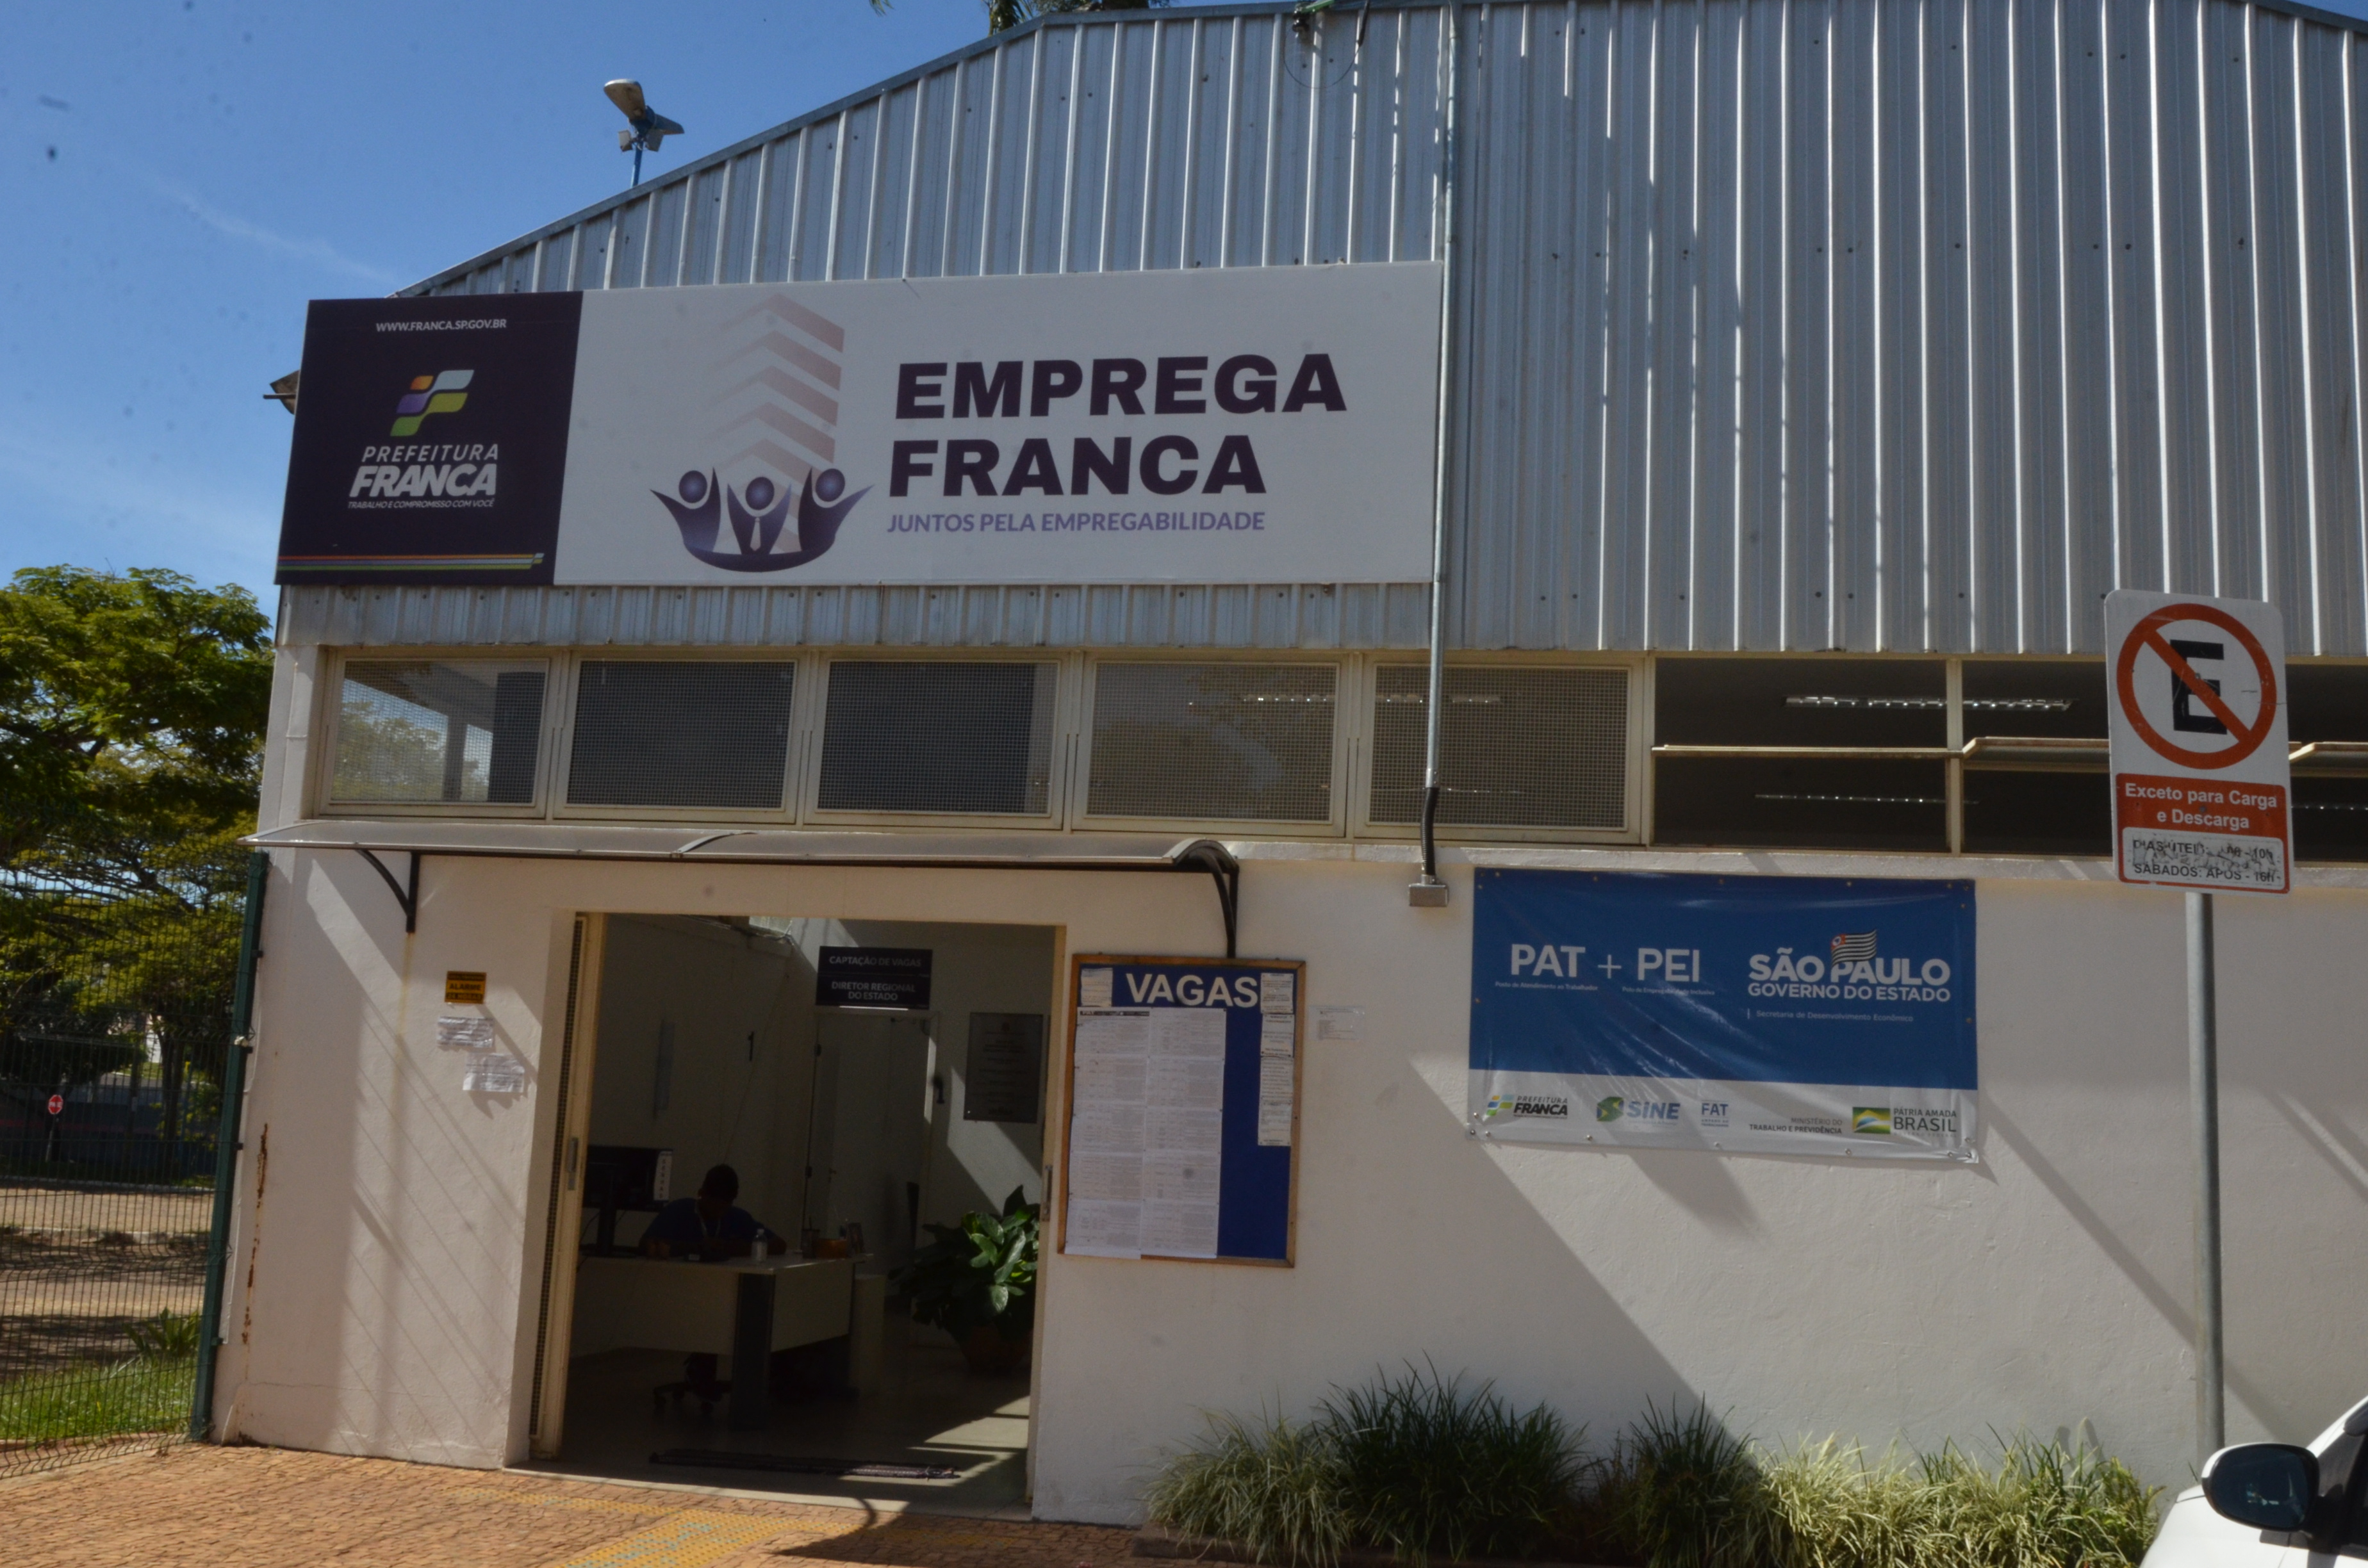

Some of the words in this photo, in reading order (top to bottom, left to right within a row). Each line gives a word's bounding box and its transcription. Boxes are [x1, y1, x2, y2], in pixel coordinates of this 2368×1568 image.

[376, 318, 507, 332] WWW.FRANCA.SP.GOV.BR
[896, 354, 1347, 419] EMPREGA
[361, 444, 498, 462] PREFEITURA
[889, 434, 1267, 497] FRANCA
[349, 463, 497, 498] FRANCA
[393, 500, 452, 508] COMPROMISSO
[473, 497, 495, 507] VOCÊ
[887, 514, 975, 533] JUNTOS
[980, 513, 1036, 532] PELA
[1041, 512, 1265, 532] EMPREGABILIDADE
[2125, 783, 2182, 800] Exceto
[2188, 790, 2224, 804] para
[2229, 790, 2277, 810] Carga
[2157, 811, 2167, 822] e
[2172, 809, 2249, 831] Descarga
[829, 956, 877, 967] CAPTAÇÃO
[892, 958, 921, 967] VAGAS
[1511, 943, 1586, 977] PAT
[1638, 948, 1700, 983] PEI
[1748, 947, 1825, 983] SÃO
[1830, 957, 1950, 986] PAULO
[832, 981, 869, 991] DIRETOR
[871, 983, 916, 992] REGIONAL
[1126, 973, 1258, 1008] VAGAS
[1748, 983, 1840, 999] GOVERNO
[1844, 985, 1872, 1000] DO
[1876, 986, 1950, 1002] ESTADO
[863, 992, 898, 1001] ESTADO
[1756, 1010, 1794, 1018] Secretaria
[1807, 1012, 1871, 1020] Desenvolvimento
[1873, 1013, 1914, 1022] Econômico
[1517, 1095, 1568, 1104] PREFEITURA
[1513, 1102, 1568, 1116] FRANCA
[1627, 1101, 1681, 1120] SINE
[1702, 1103, 1729, 1116] FAT
[1893, 1107, 1923, 1116] PÁTRIA
[1925, 1109, 1957, 1118] AMADA
[1791, 1117, 1832, 1125] MINISTÉRIO
[1893, 1116, 1957, 1132] BRASIL
[1795, 1125, 1843, 1134] PREVIDÊNCIA
